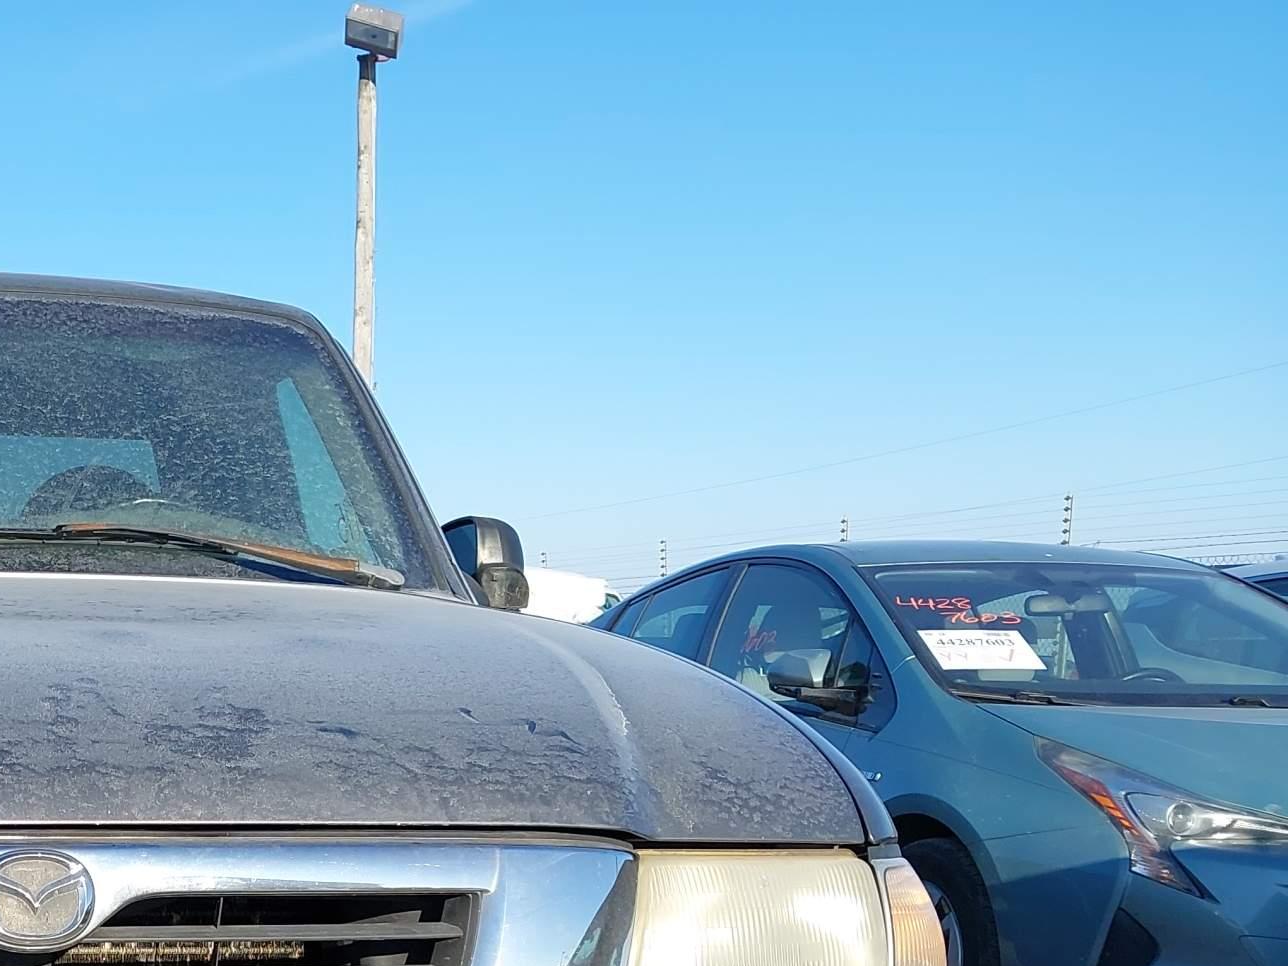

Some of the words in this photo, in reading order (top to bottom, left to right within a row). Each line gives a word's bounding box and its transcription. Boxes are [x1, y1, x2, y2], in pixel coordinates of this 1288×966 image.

[896, 596, 972, 611] 4428
[939, 610, 1022, 625] 7603
[936, 638, 1016, 647] 44287603
